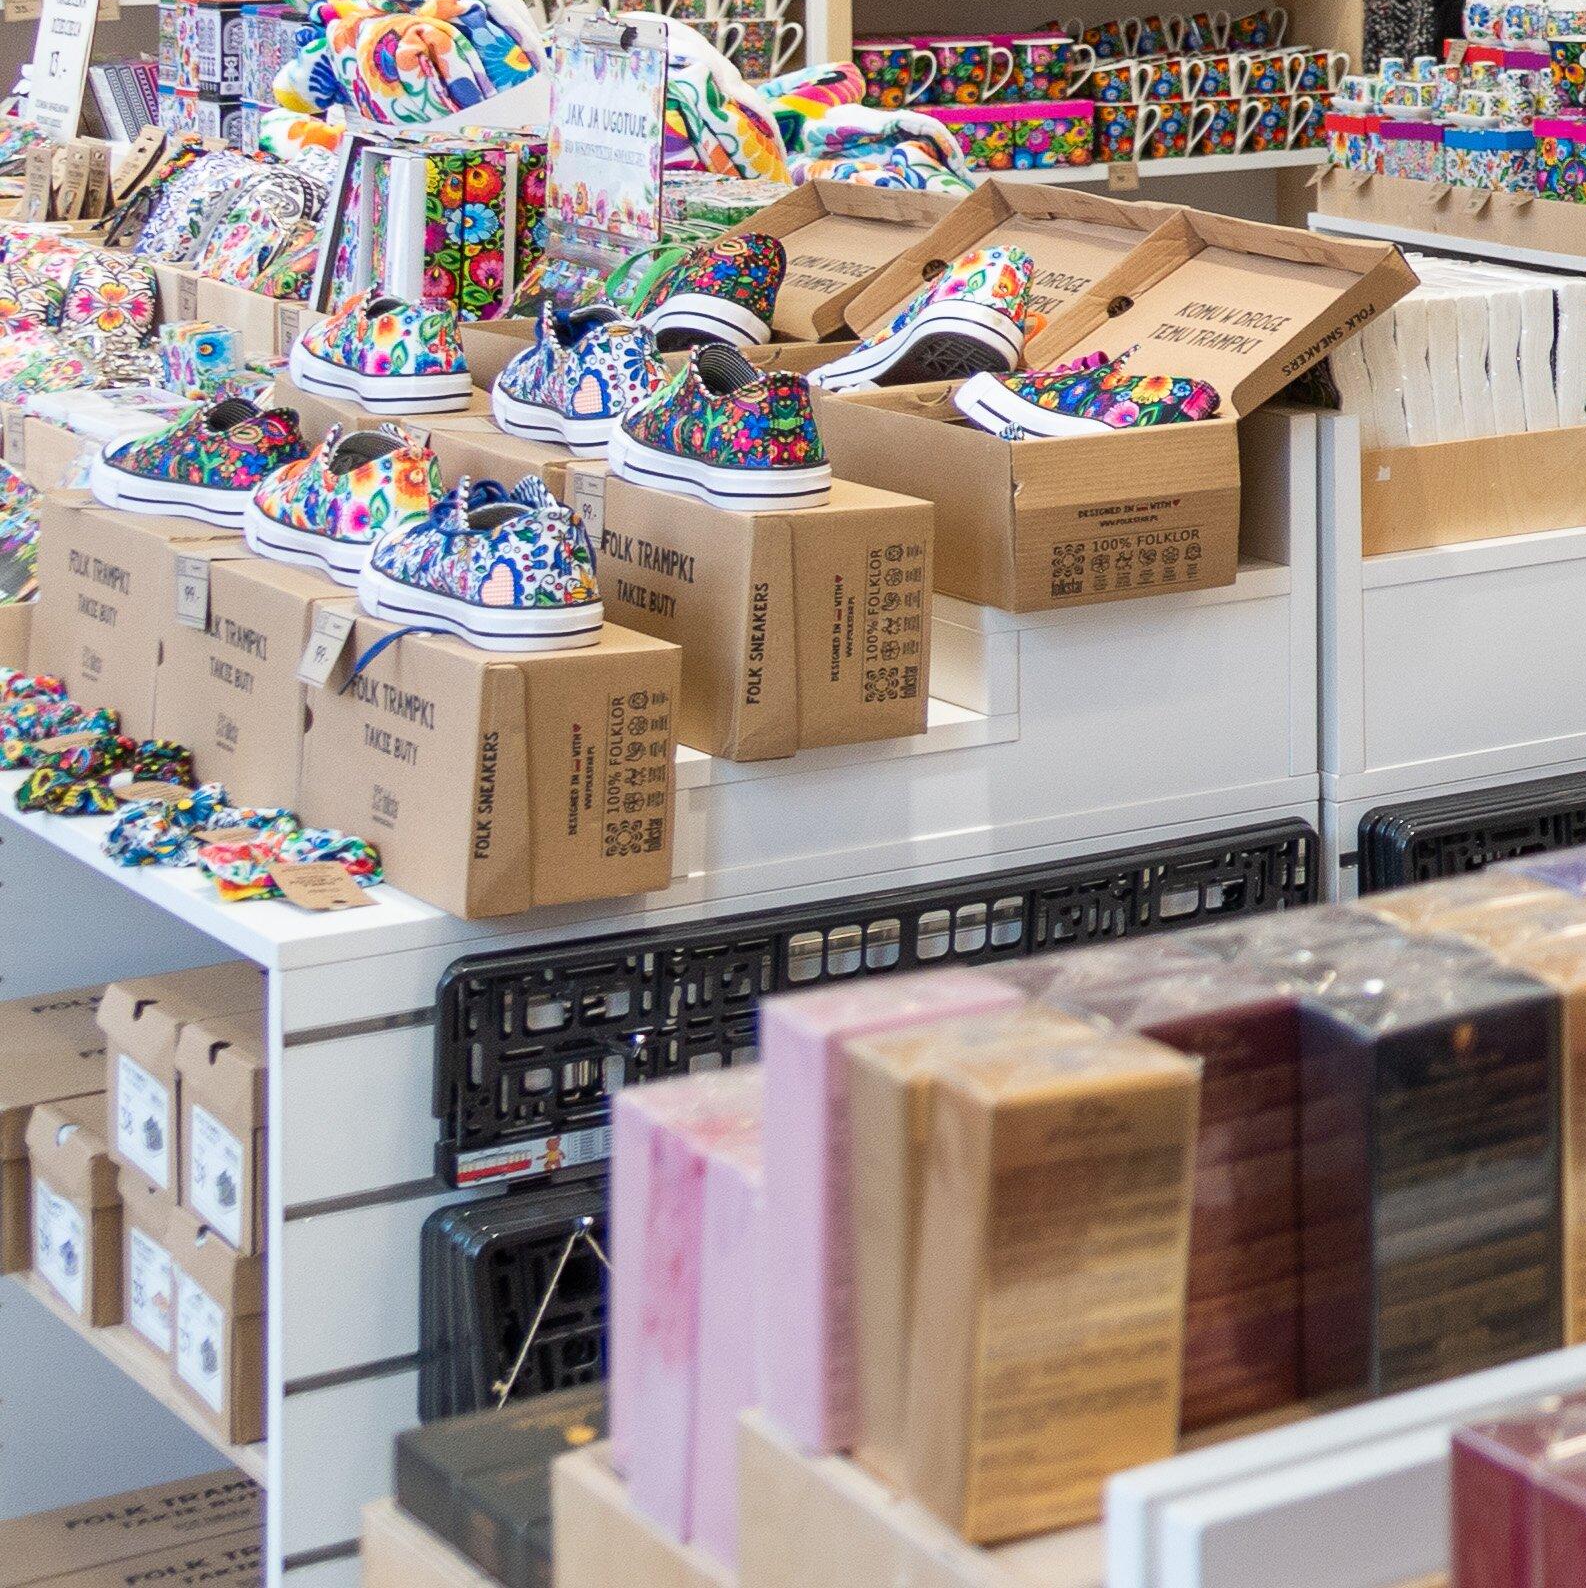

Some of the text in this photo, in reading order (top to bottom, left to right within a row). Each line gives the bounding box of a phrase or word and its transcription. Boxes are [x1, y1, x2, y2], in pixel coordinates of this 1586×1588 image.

[1176, 301, 1223, 323] KOMU
[1148, 323, 1263, 355] TEMU TRAMPKI
[1281, 302, 1377, 377] FOLK SNEAKERS
[601, 529, 695, 584] FOLK TRAMPKI
[1092, 529, 1201, 553] 100% FOLKLOR
[617, 578, 677, 619] TAKIE BUTY
[866, 548, 883, 663] 100% FOLKLOR
[746, 581, 770, 705] FOLK SNEAKERS
[382, 682, 436, 731] TRAMPKI
[364, 722, 421, 767] TAKIE BUTY
[606, 695, 625, 815] 100% FOLKLOR
[473, 730, 500, 860] FOLK SNEAKERS
